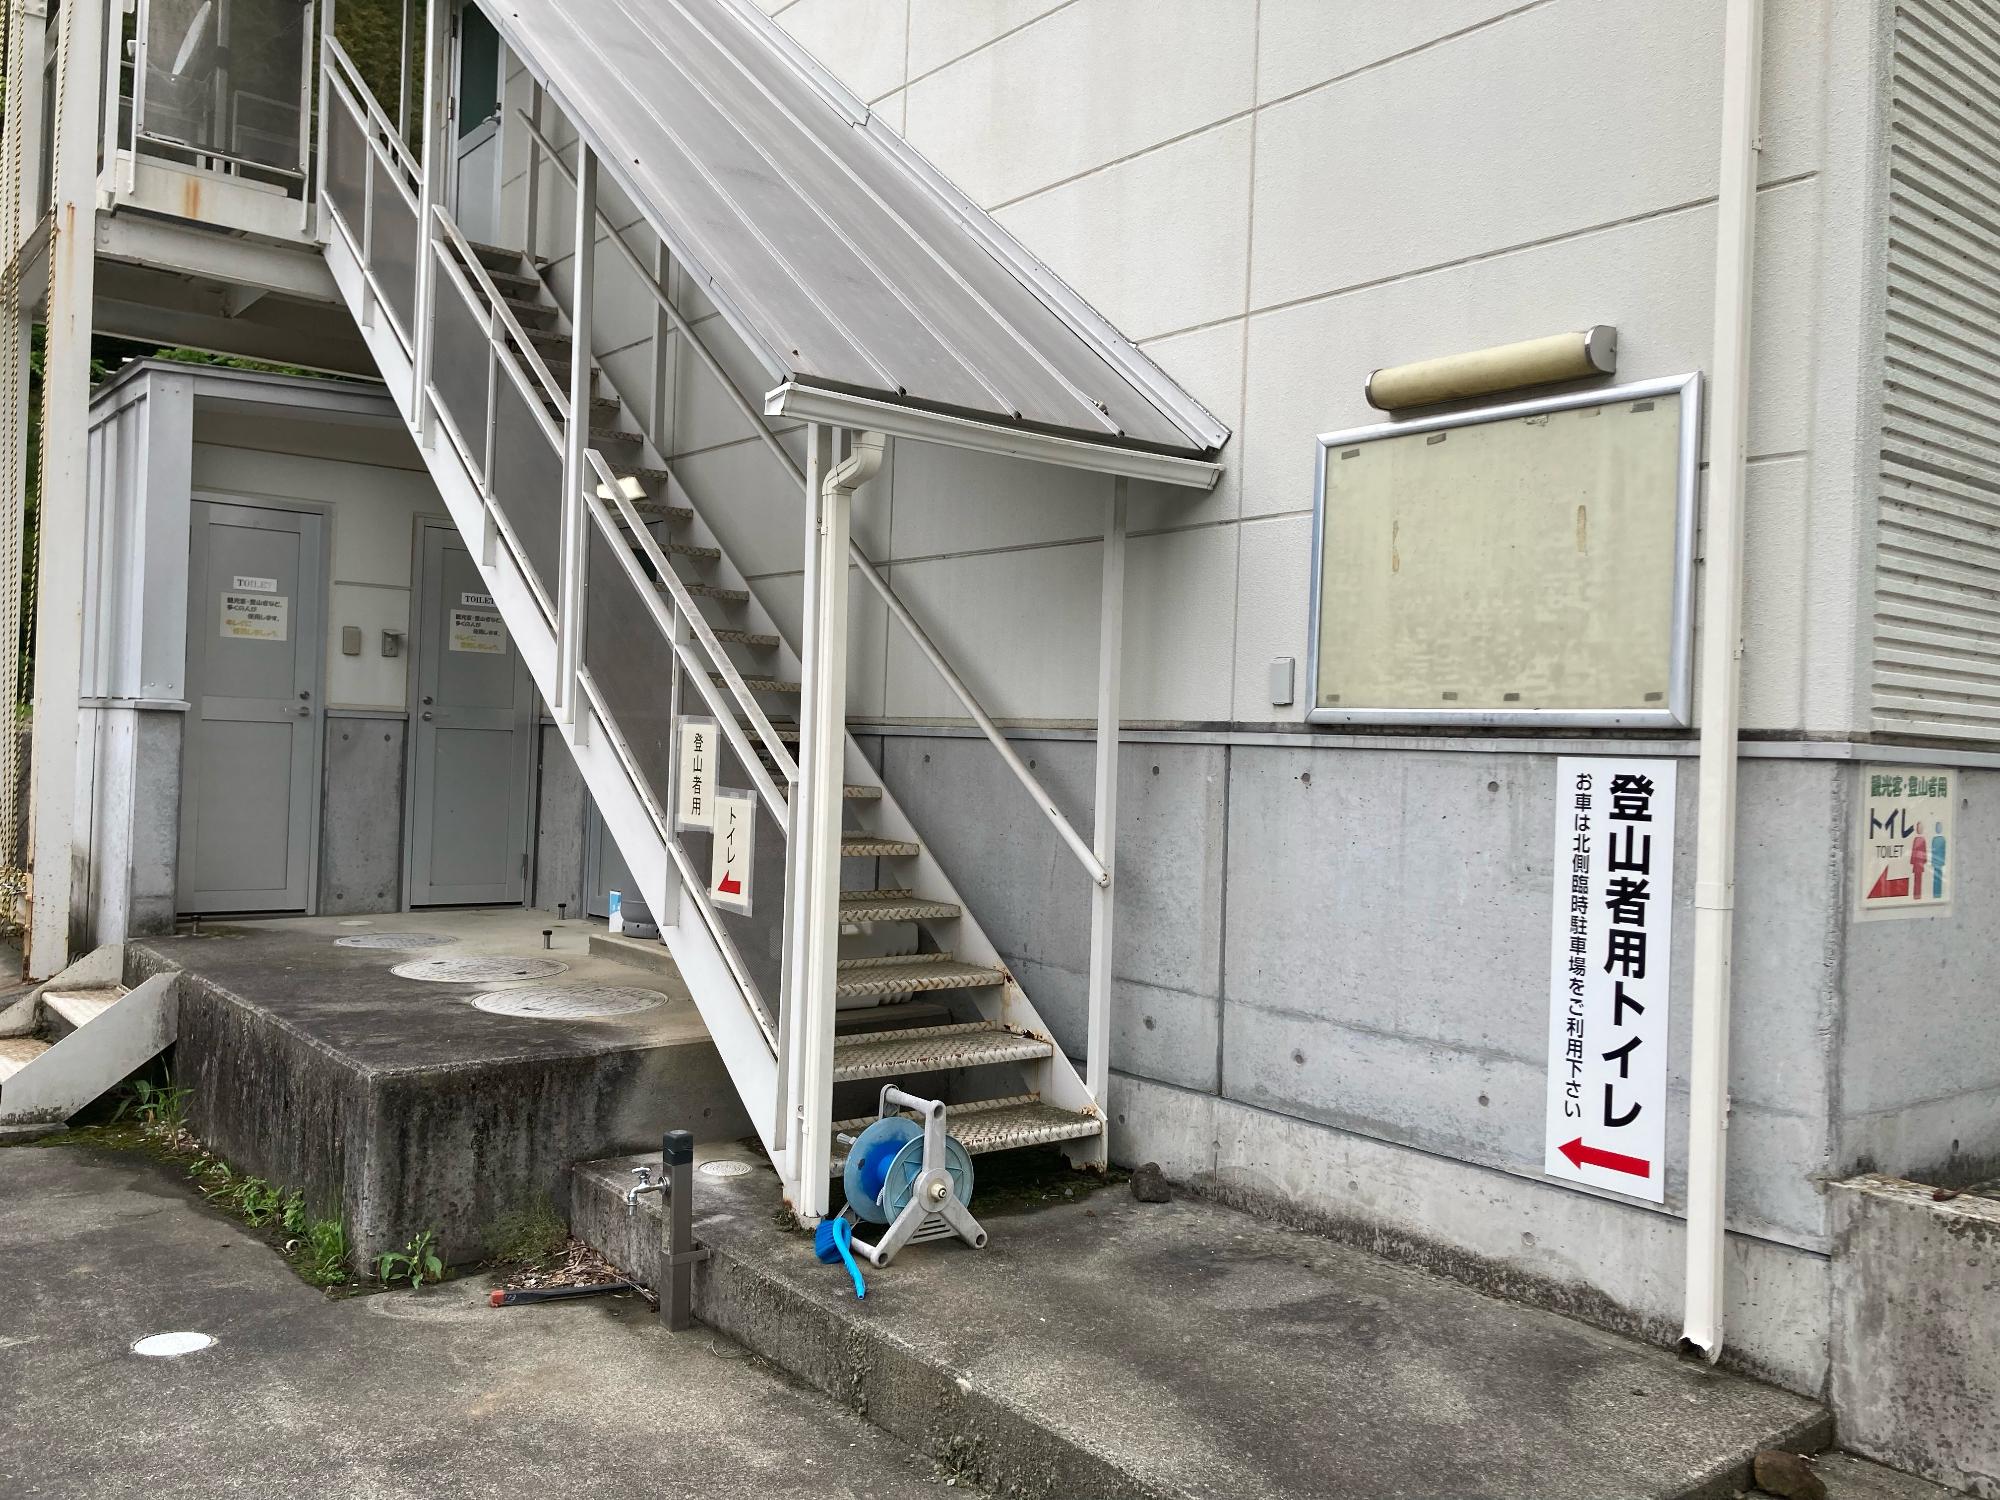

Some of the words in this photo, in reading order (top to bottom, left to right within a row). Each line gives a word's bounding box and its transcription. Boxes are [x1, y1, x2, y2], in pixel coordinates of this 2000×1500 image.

[465, 595, 494, 604] TOILET
[691, 732, 704, 816] 登山者用
[1870, 774, 1948, 798] 観光客・登山者用
[726, 806, 737, 864] トイレ
[1869, 807, 1915, 840] トイレ
[1875, 844, 1905, 859] TOILET
[1564, 772, 1593, 1118] お車は北側臨時駐車場をご利用下さい
[1601, 774, 1655, 1128] 登山者用トイレ
